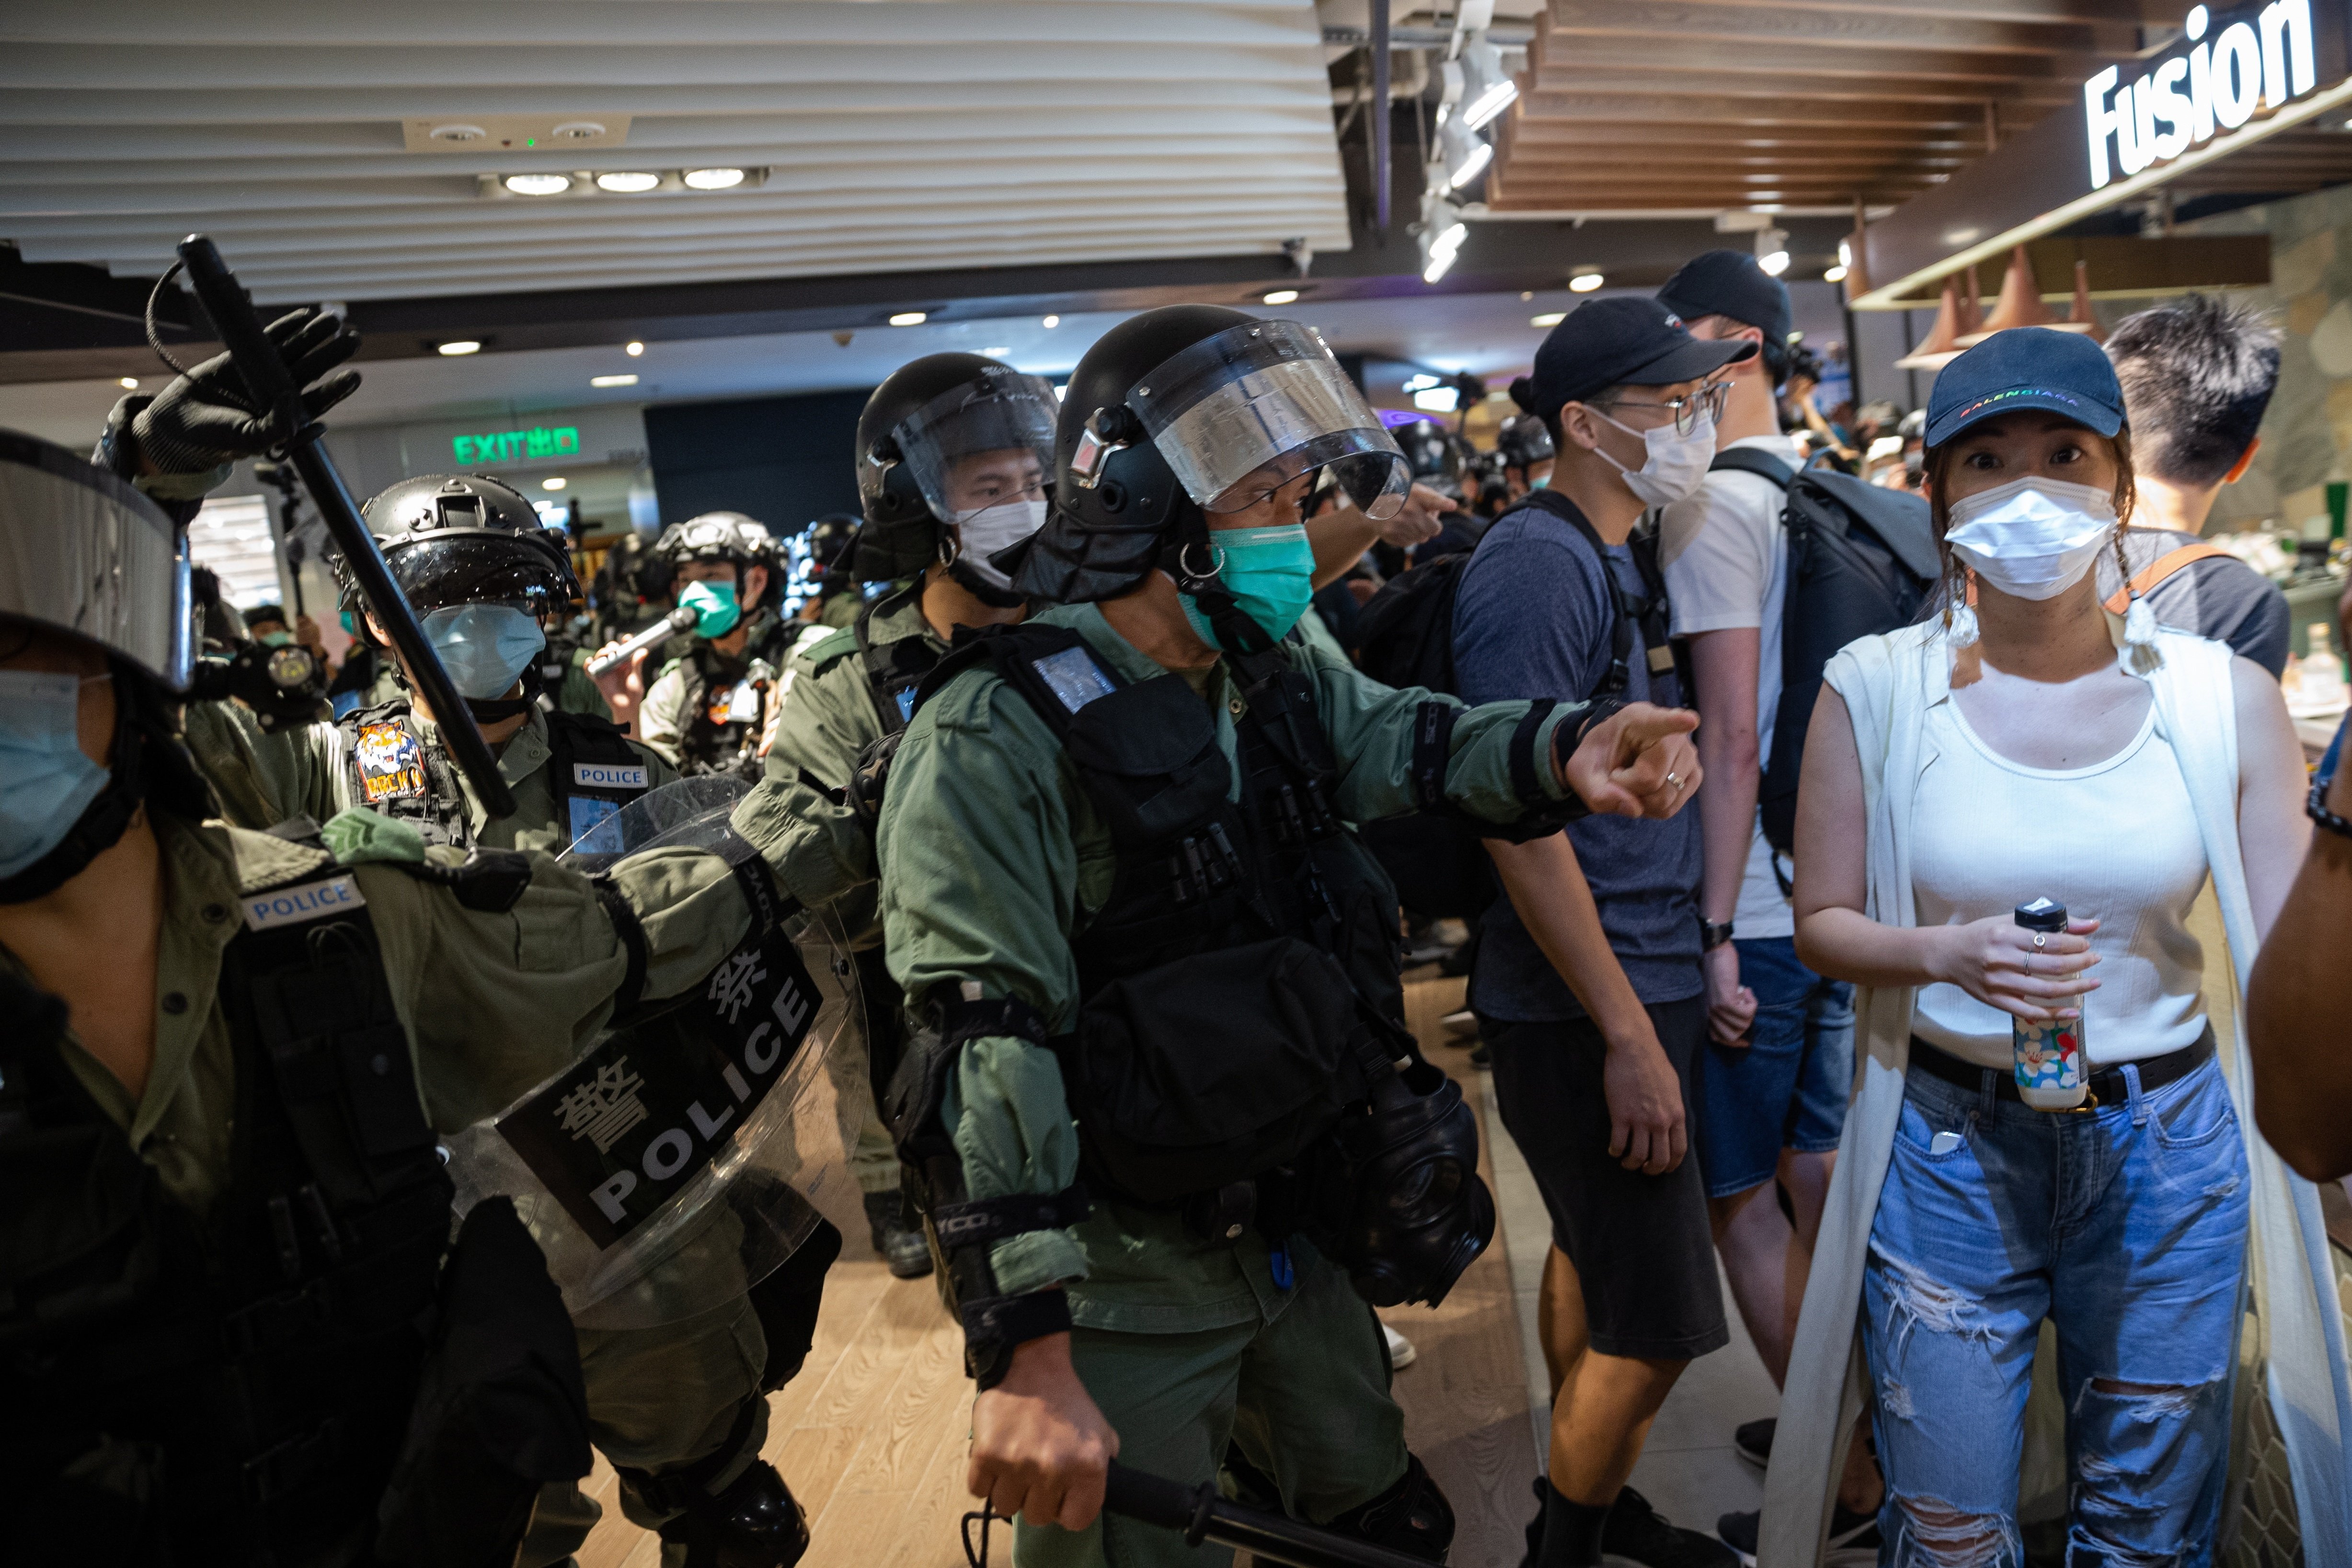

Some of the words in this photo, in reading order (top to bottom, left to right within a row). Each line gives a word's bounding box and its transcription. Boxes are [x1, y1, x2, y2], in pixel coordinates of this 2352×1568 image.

[2085, 0, 2316, 190] Fusion
[453, 432, 526, 464] EXIT
[527, 427, 579, 458] 出口
[581, 769, 642, 783] POLICE
[253, 883, 351, 921] POLICE
[589, 976, 809, 1225] POLICE
